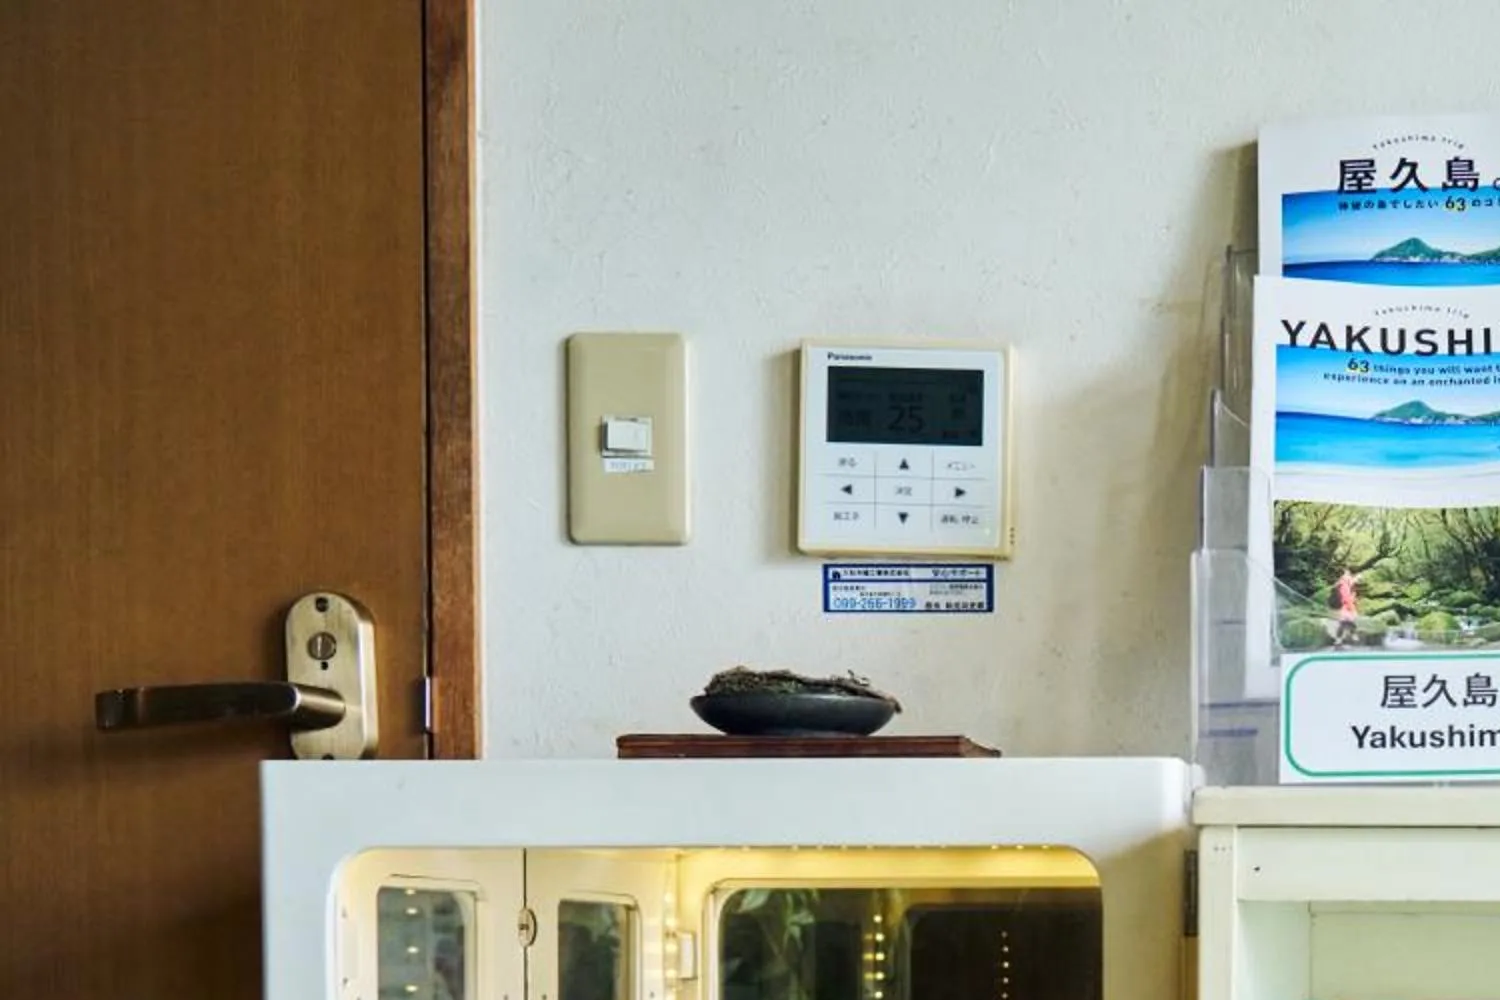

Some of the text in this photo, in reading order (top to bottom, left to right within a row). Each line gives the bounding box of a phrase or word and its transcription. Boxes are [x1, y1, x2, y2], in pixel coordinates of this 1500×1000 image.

[827, 352, 873, 362] Panasonic
[1348, 358, 1370, 374] 63
[1374, 363, 1411, 376] things
[1414, 366, 1435, 376] you
[1438, 364, 1461, 375] will
[1464, 363, 1493, 374] want
[1324, 372, 1389, 386] experience
[1411, 377, 1426, 386] an
[1429, 374, 1491, 386] enchanted
[888, 403, 926, 434] 25
[1380, 673, 1499, 709] 屋久島
